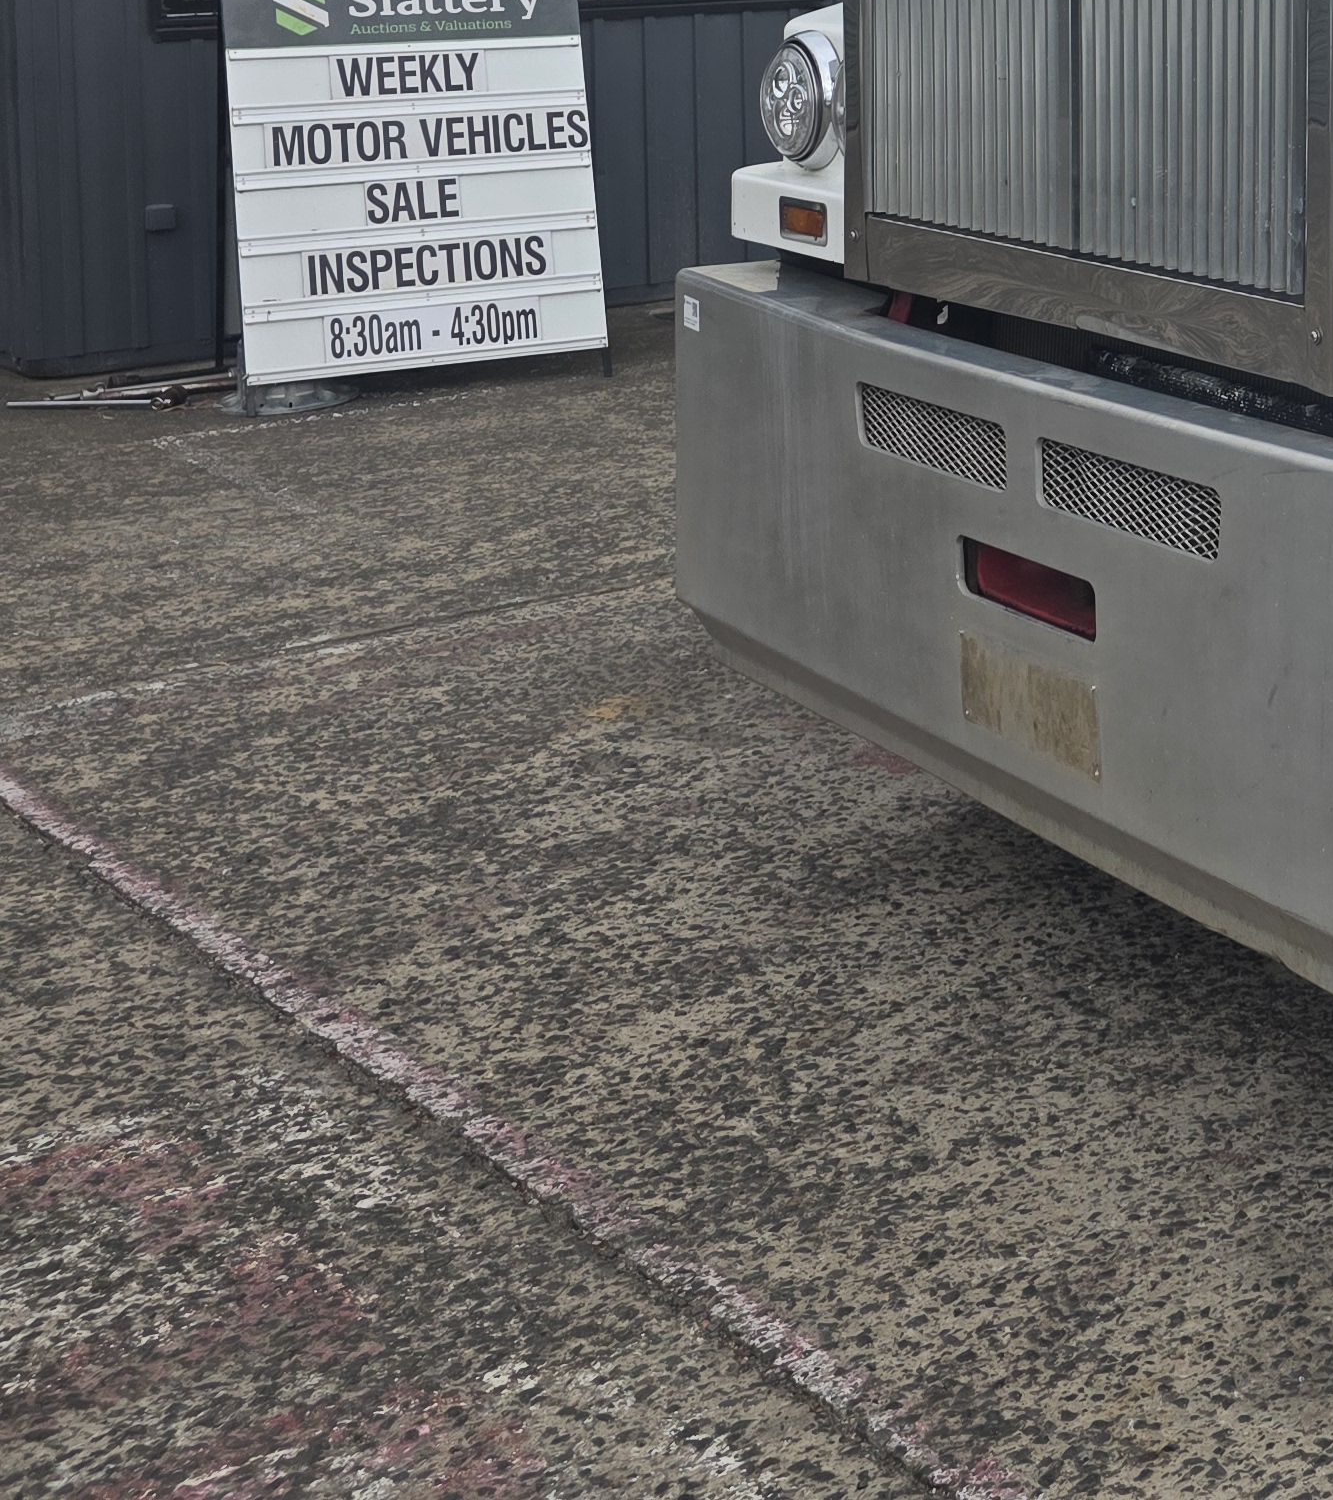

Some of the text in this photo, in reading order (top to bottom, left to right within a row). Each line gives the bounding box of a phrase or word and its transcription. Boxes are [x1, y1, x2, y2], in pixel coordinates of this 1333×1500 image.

[351, 19, 511, 34] Auctions & Valuations
[336, 53, 479, 97] WEEKLY
[272, 109, 588, 167] MOTOR VEHICLES
[366, 178, 460, 224] SALE
[307, 235, 547, 296] INSPECTIONS
[330, 314, 422, 359] 8:30am
[450, 303, 538, 346] 4:30pm
